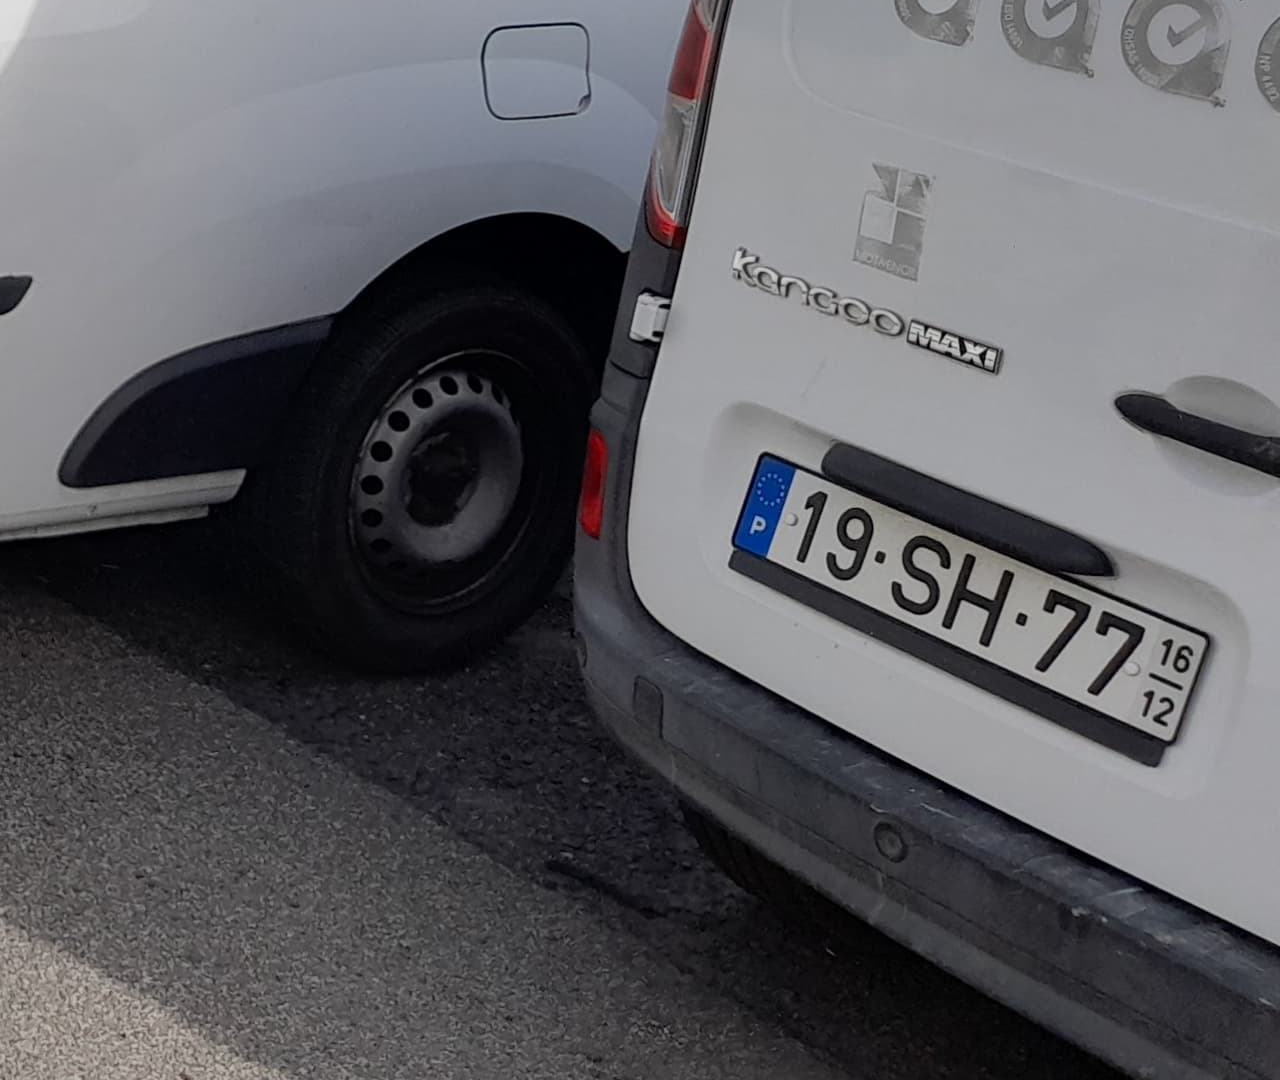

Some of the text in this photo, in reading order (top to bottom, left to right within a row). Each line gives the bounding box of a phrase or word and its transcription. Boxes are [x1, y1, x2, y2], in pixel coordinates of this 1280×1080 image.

[908, 322, 999, 370] MAXI
[750, 515, 767, 535] P
[1160, 637, 1195, 675] 16
[1141, 689, 1176, 727] 12
